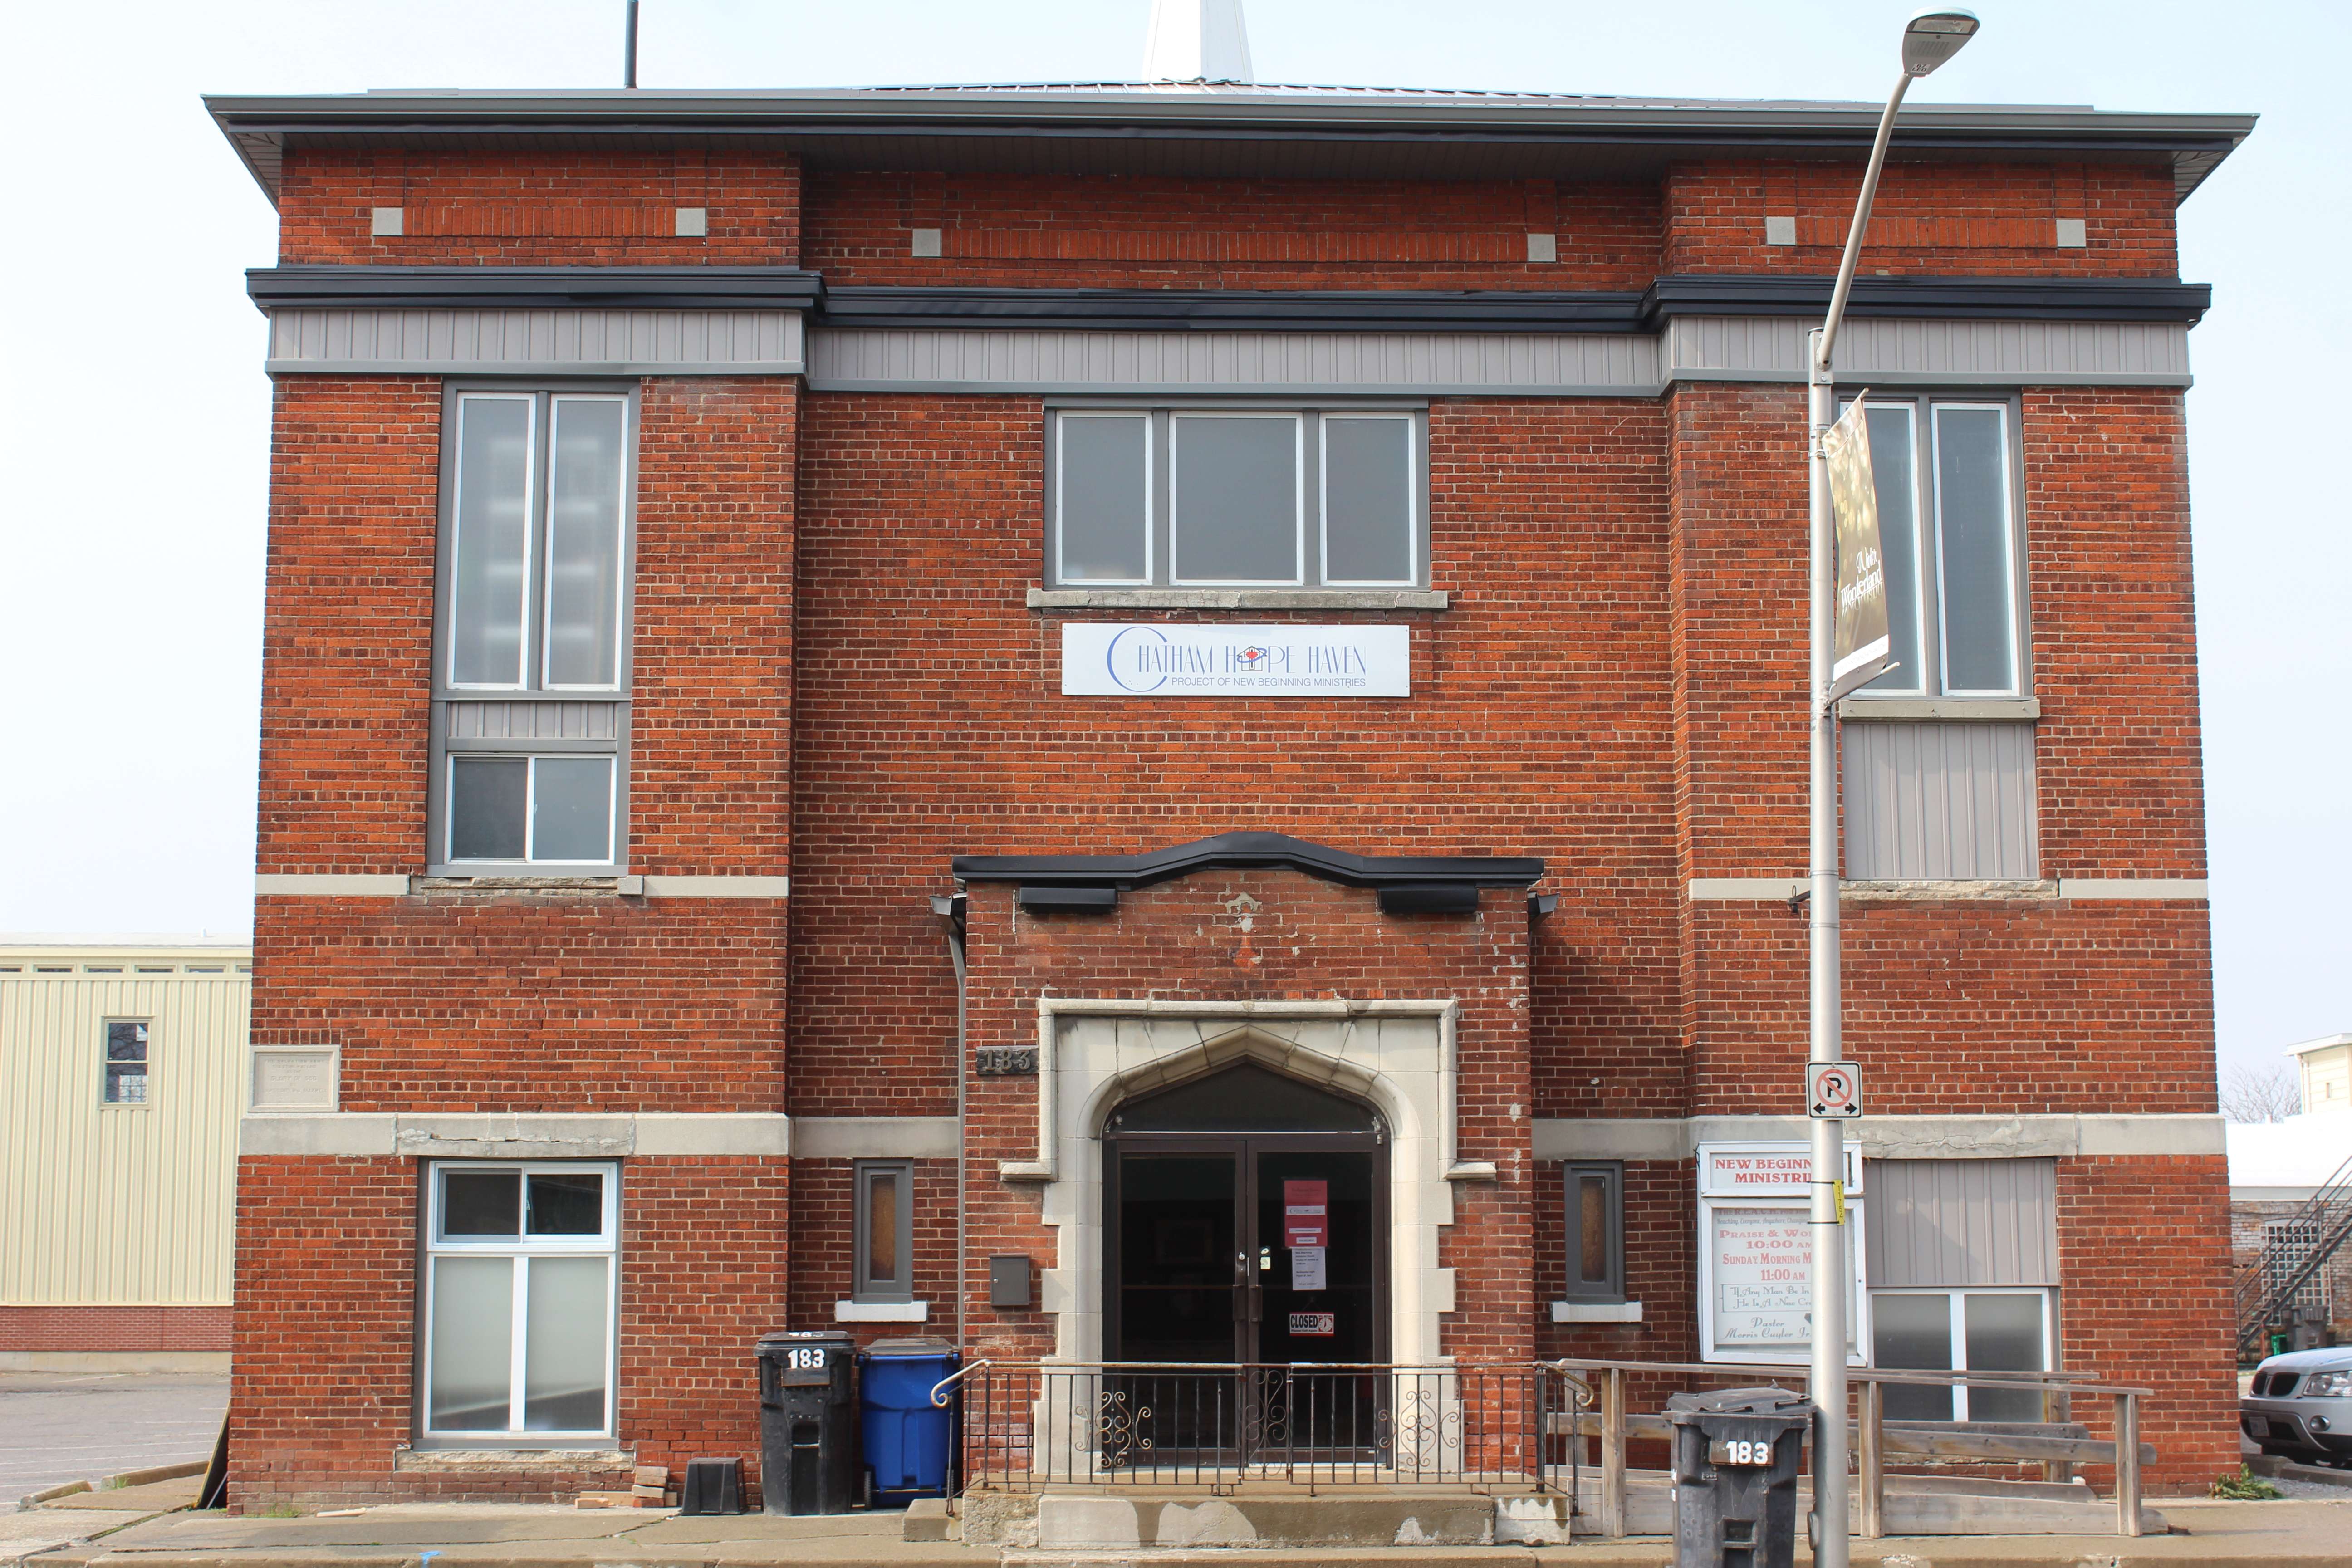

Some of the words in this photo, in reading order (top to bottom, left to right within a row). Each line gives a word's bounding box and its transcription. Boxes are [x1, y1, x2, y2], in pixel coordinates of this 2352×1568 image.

[1107, 626, 1213, 692] CHATHAM
[1309, 645, 1366, 676] HAVEN
[1172, 677, 1215, 686] PROJECT
[1217, 677, 1231, 686] OF
[1233, 677, 1255, 686] NEW
[1258, 678, 1311, 686] BEGINNING
[1314, 678, 1366, 687] MINISTRIES
[985, 1049, 1031, 1071] 183
[1715, 1159, 1751, 1169] NEW
[1756, 1159, 1811, 1169] BEGINN
[1735, 1173, 1811, 1183] MINISTRI
[1767, 1229, 1779, 1237] &
[1746, 1240, 1793, 1249] 10:00
[1723, 1254, 1758, 1264] SUNDAY
[1760, 1253, 1800, 1264] MORNING
[1761, 1269, 1790, 1280] 11:00
[1793, 1272, 1805, 1280] AM
[1740, 1287, 1760, 1297] Any
[1786, 1285, 1798, 1294] Be
[1801, 1286, 1809, 1294] In
[1733, 1298, 1749, 1309] He
[1291, 1315, 1318, 1328] CLOSED
[1750, 1317, 1784, 1328] Pastor
[1720, 1328, 1758, 1339] Morris
[788, 1348, 825, 1369] 183
[1726, 1440, 1769, 1465] 183
